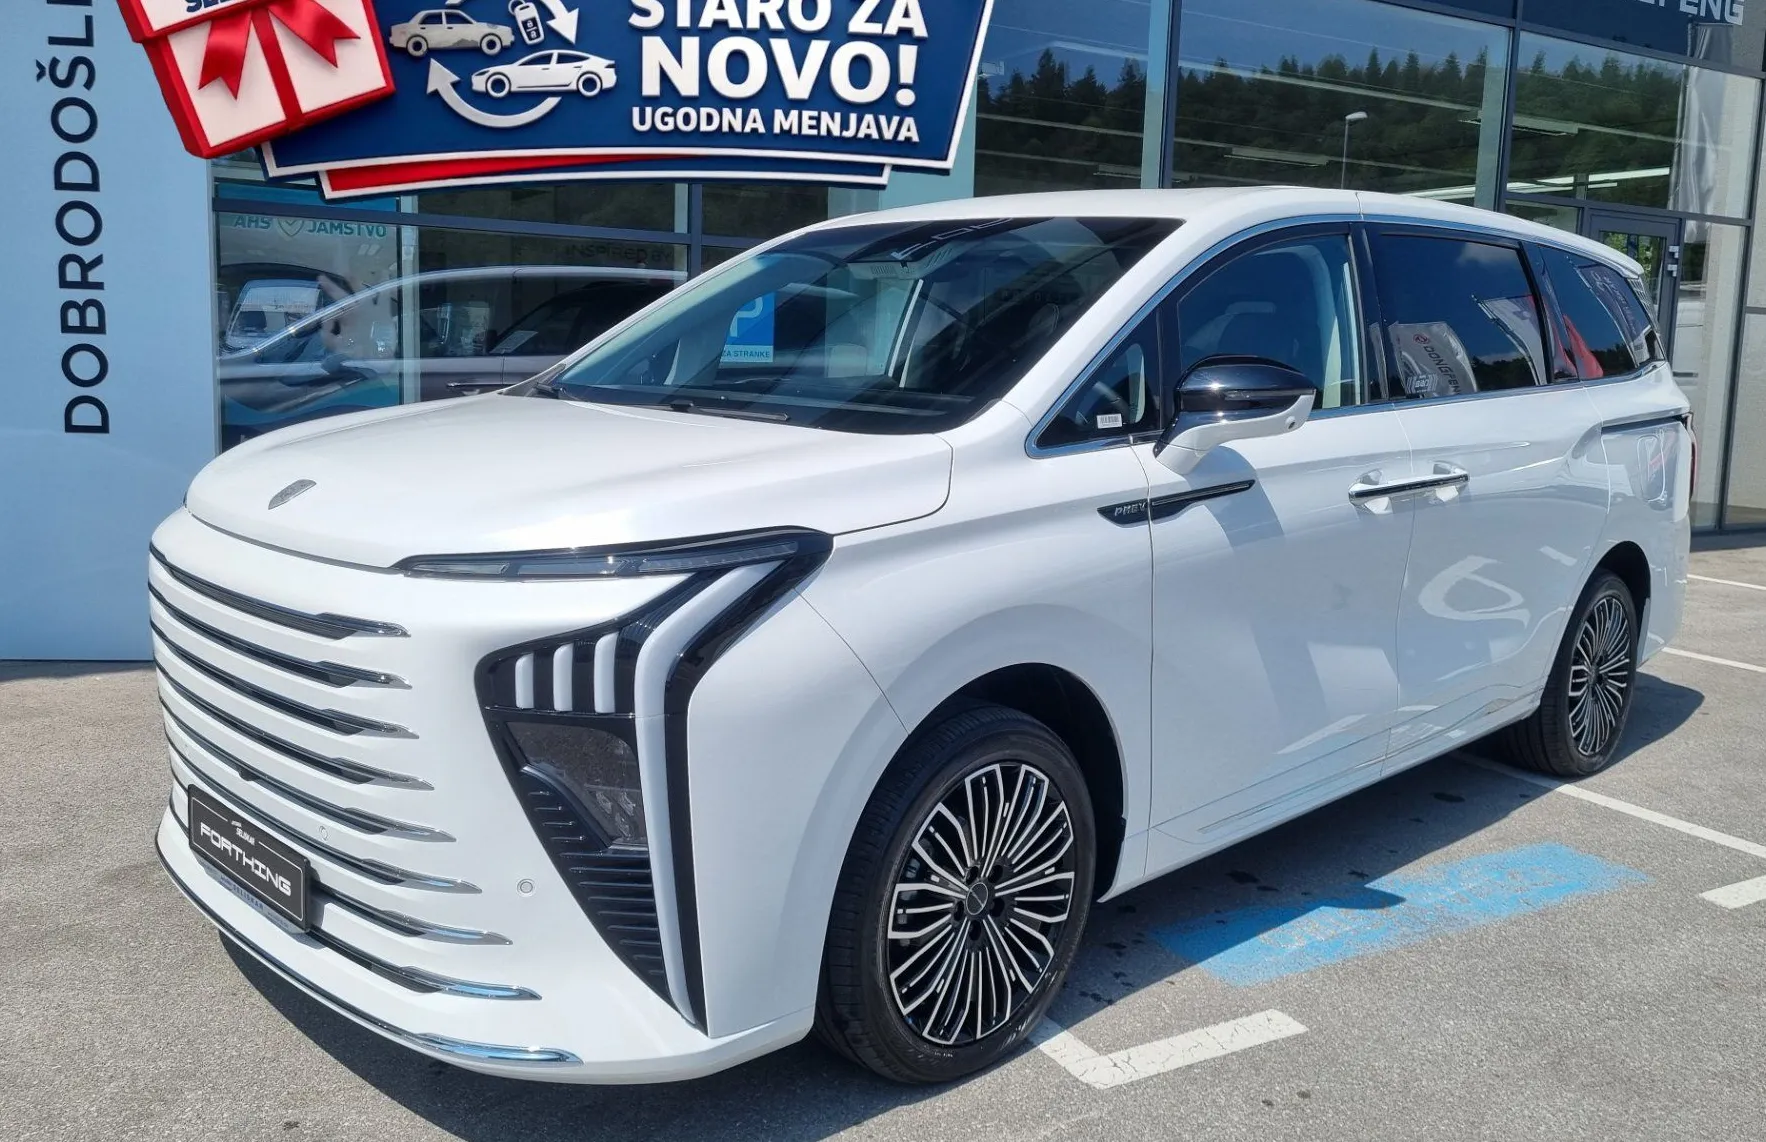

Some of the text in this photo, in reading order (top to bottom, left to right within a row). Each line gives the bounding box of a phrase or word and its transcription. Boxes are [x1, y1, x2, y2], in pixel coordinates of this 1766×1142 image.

[233, 216, 272, 230] AHS
[734, 350, 770, 358] STRANKE
[1114, 502, 1146, 516] PHEV
[200, 822, 292, 897] FORTHING
